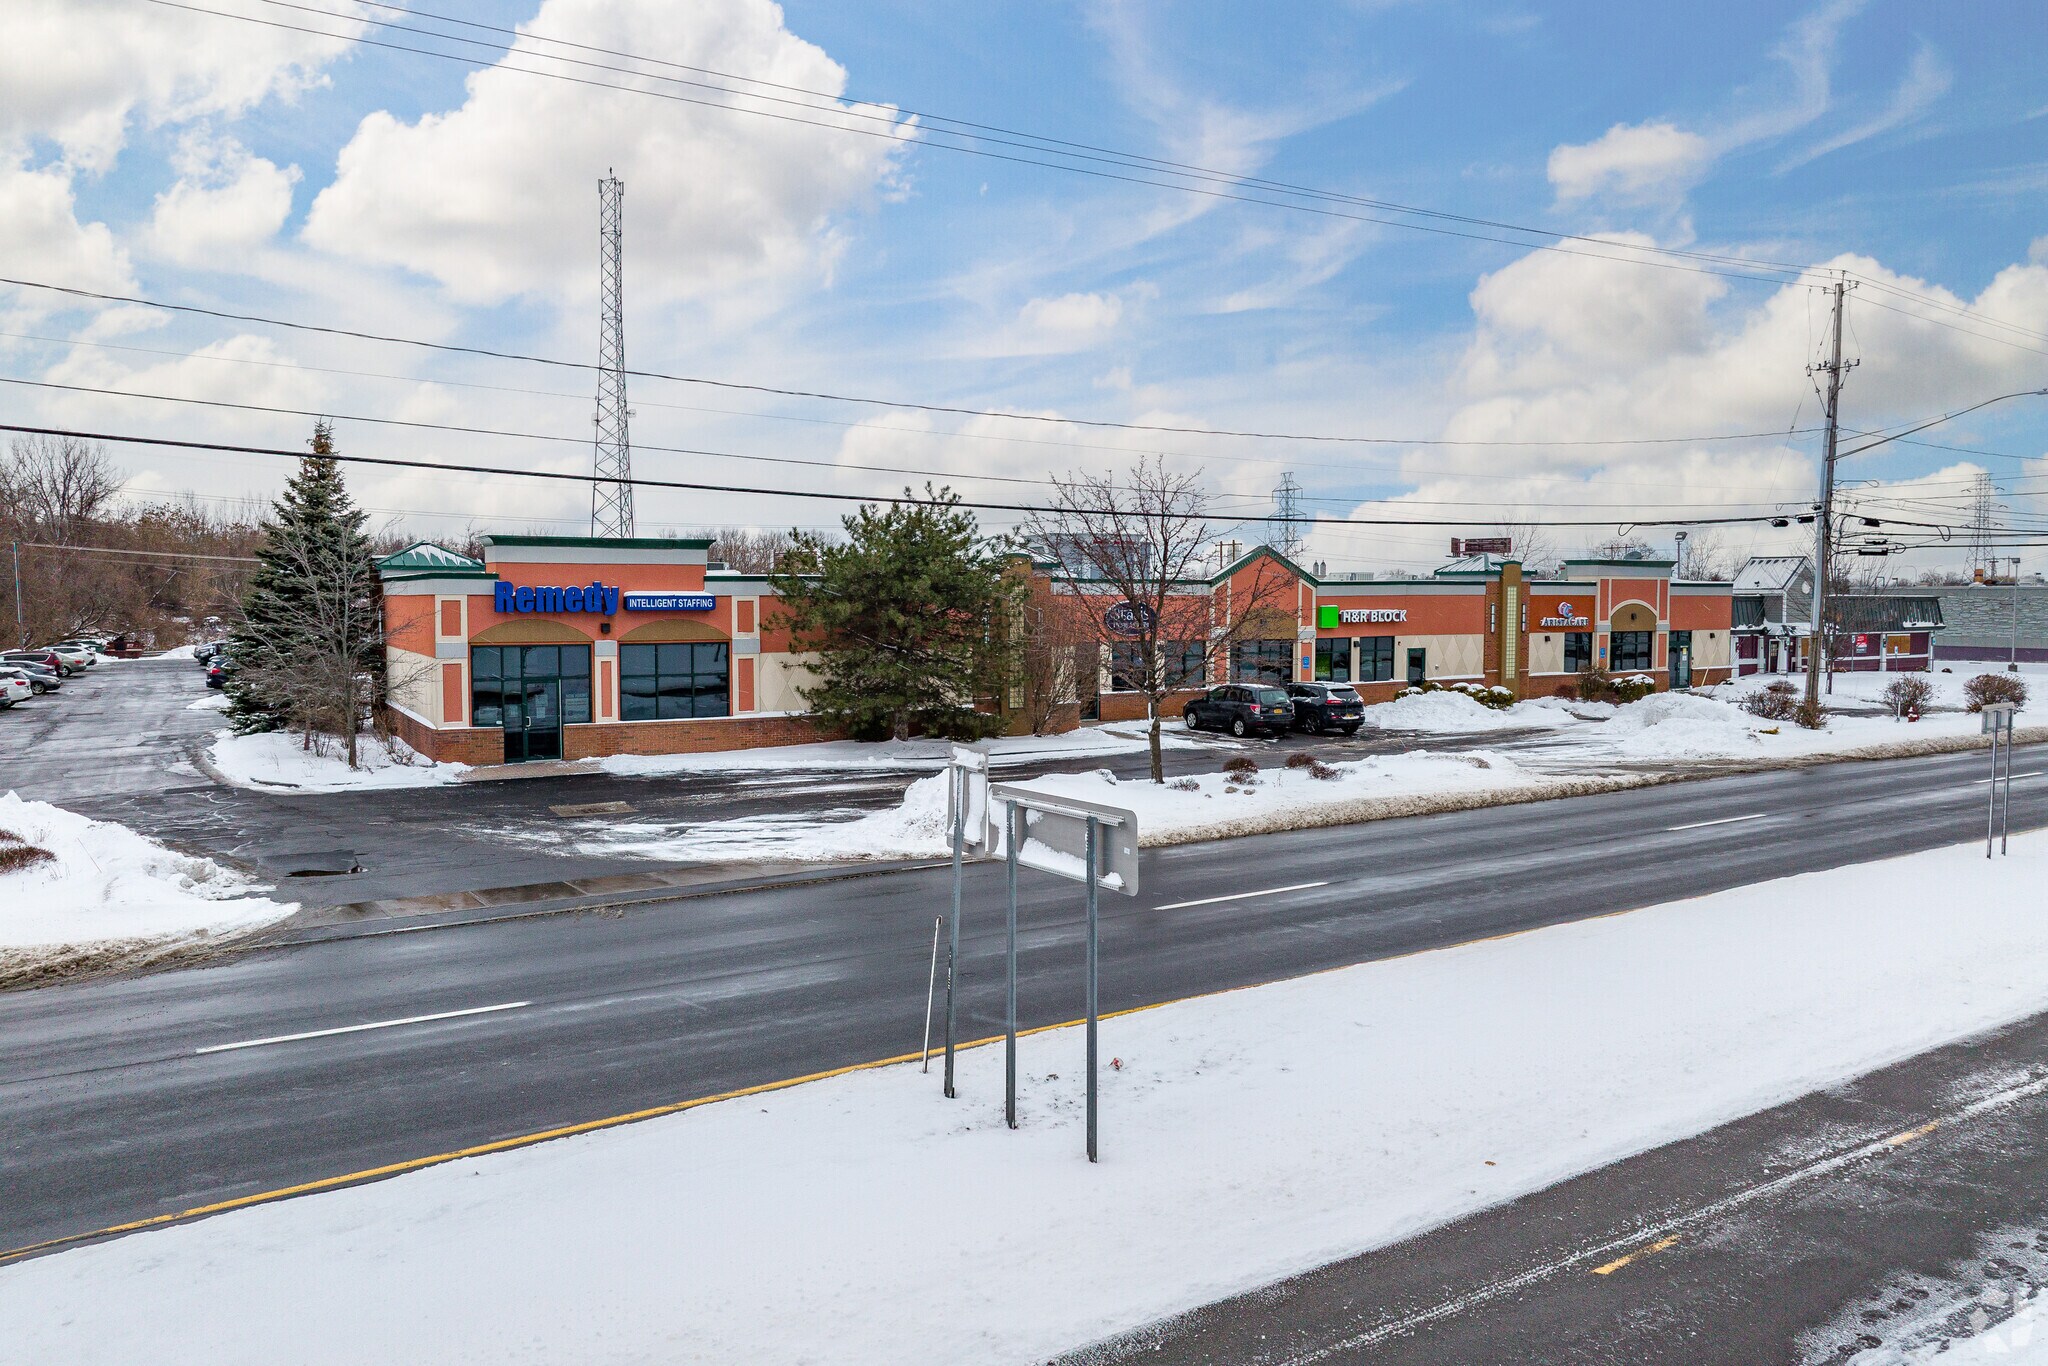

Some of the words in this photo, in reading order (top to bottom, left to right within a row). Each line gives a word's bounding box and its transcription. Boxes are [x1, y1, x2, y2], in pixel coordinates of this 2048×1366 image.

[494, 581, 619, 615] Remedy
[629, 598, 677, 608] INTELLIGENT
[678, 598, 713, 609] STAFFING
[1342, 610, 1367, 623] H&R
[1370, 609, 1407, 622] BLOCK
